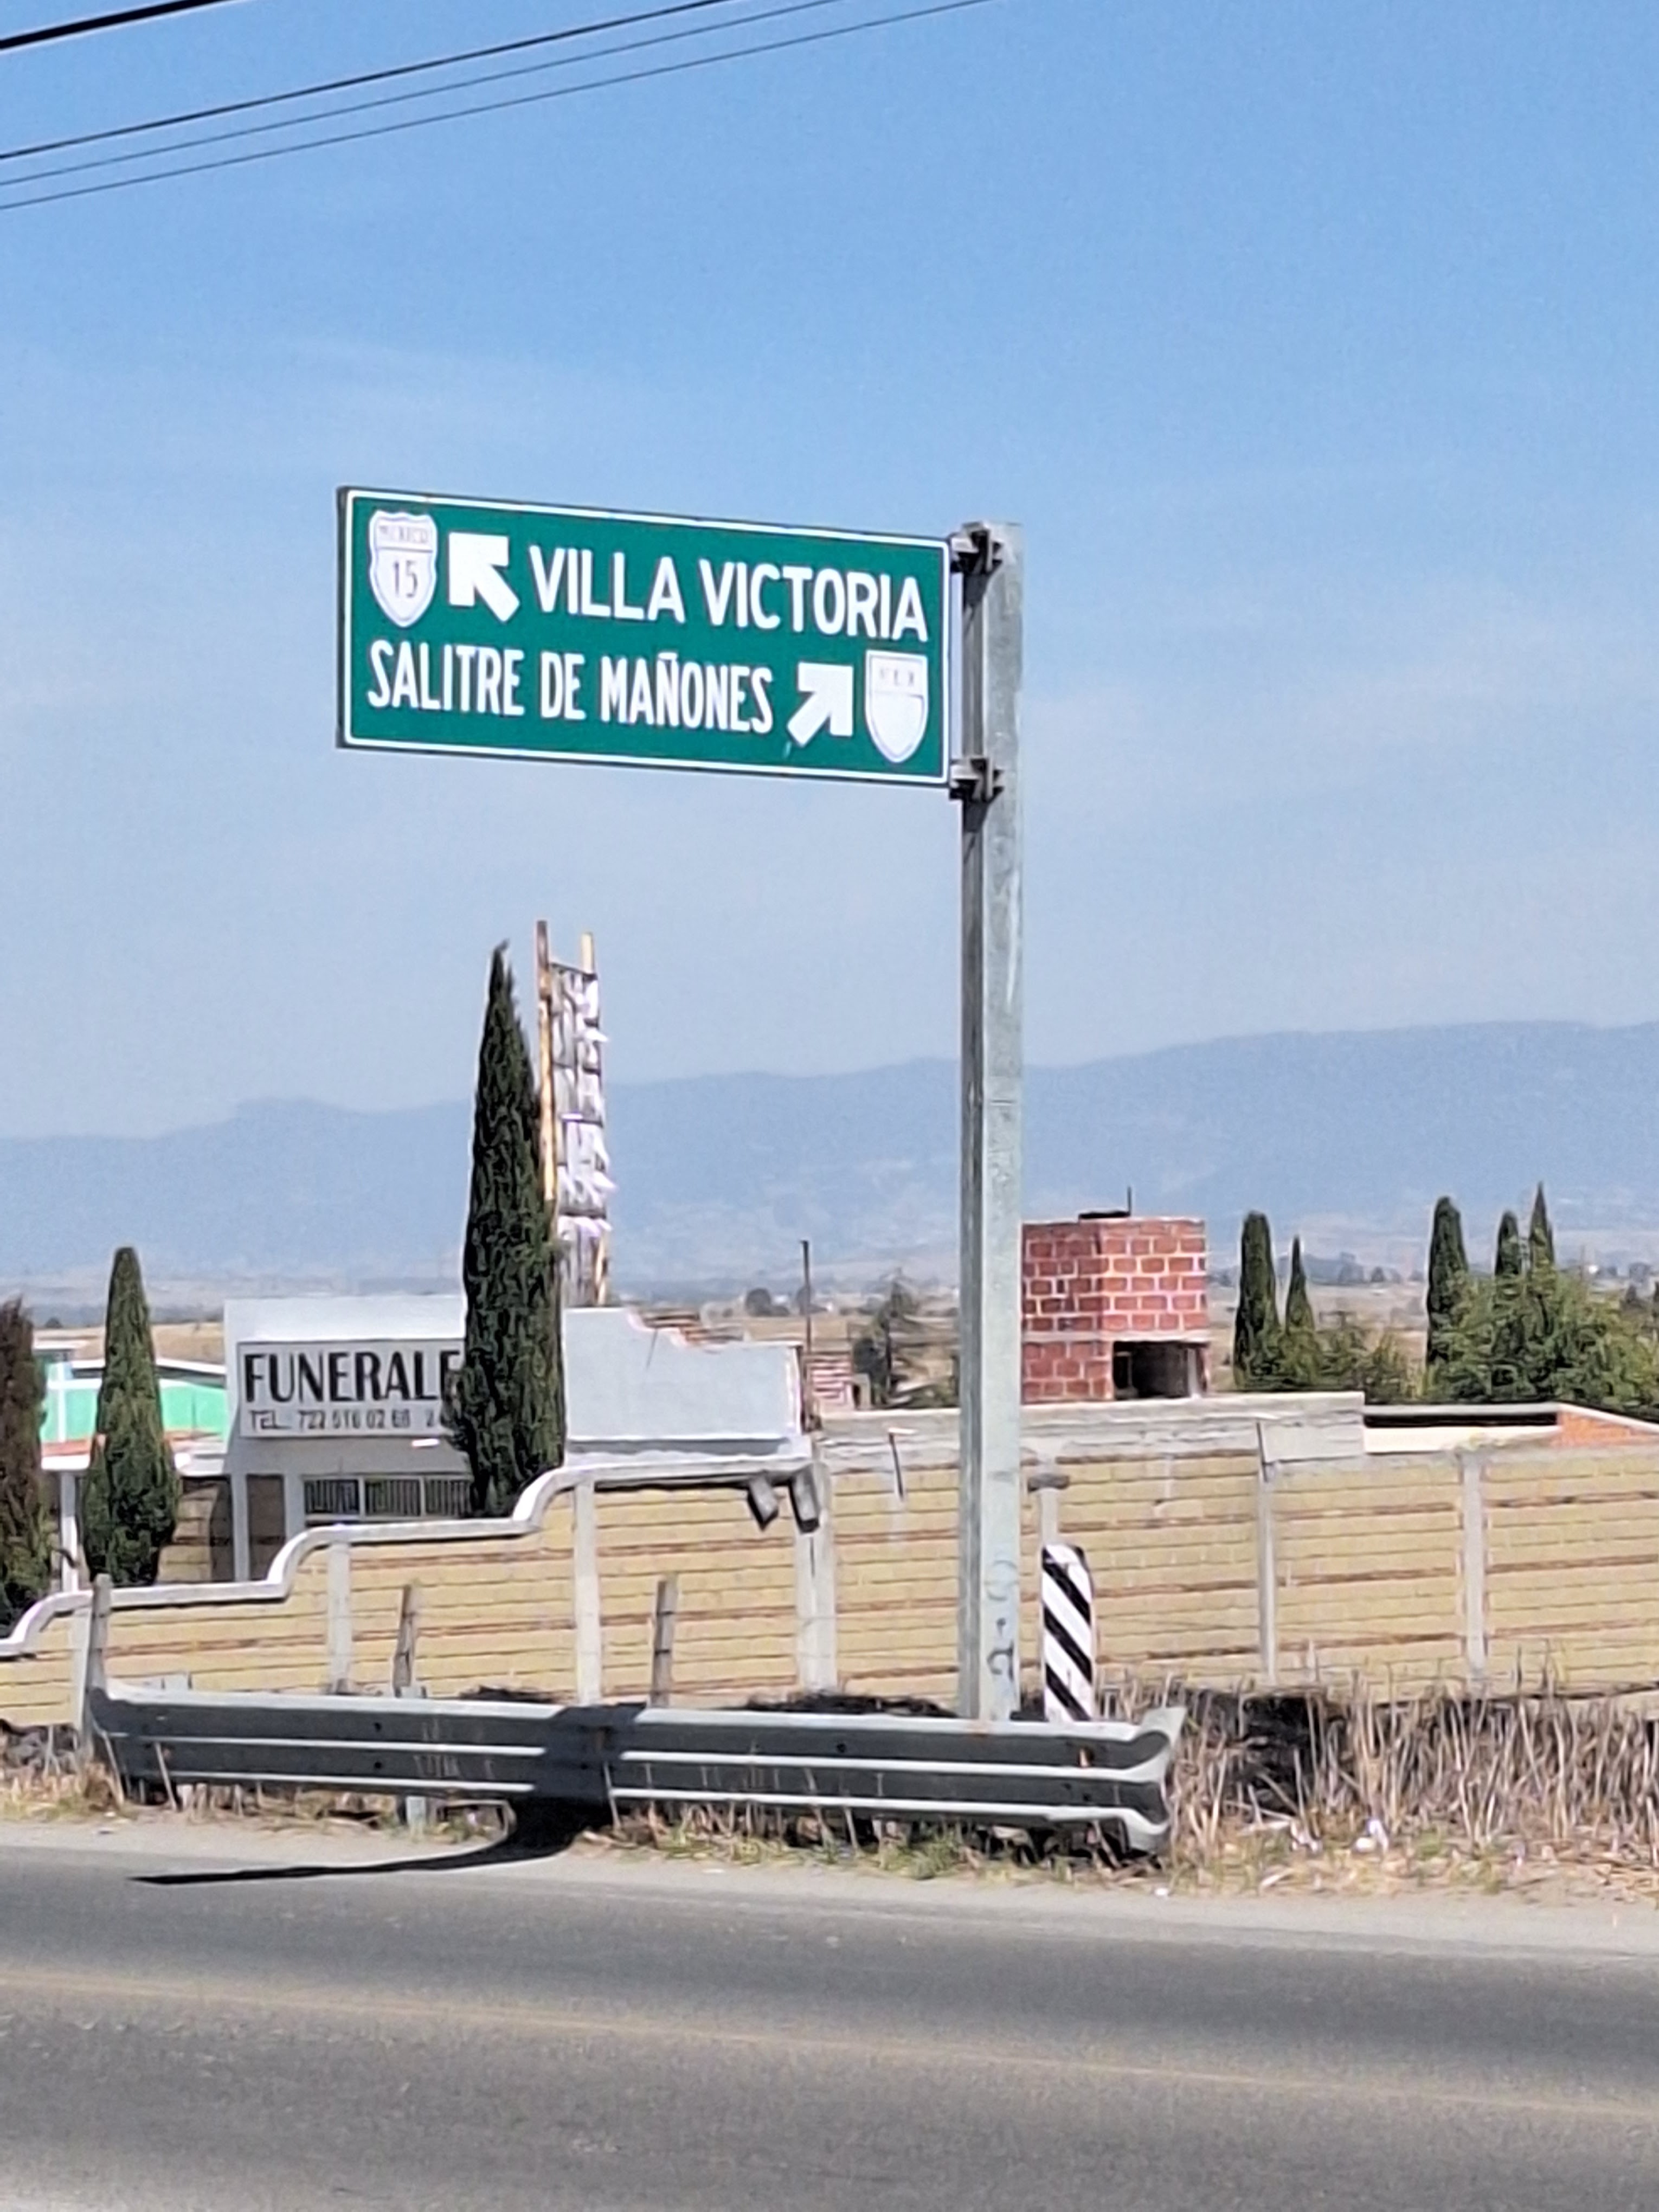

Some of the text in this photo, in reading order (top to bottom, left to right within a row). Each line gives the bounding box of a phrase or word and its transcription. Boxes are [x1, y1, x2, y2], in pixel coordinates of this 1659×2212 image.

[394, 560, 417, 598] 15
[529, 545, 928, 642] VILLA VICTORIA
[368, 639, 773, 734] SALITRE DE MAÑONES
[365, 1408, 385, 1429] 02
